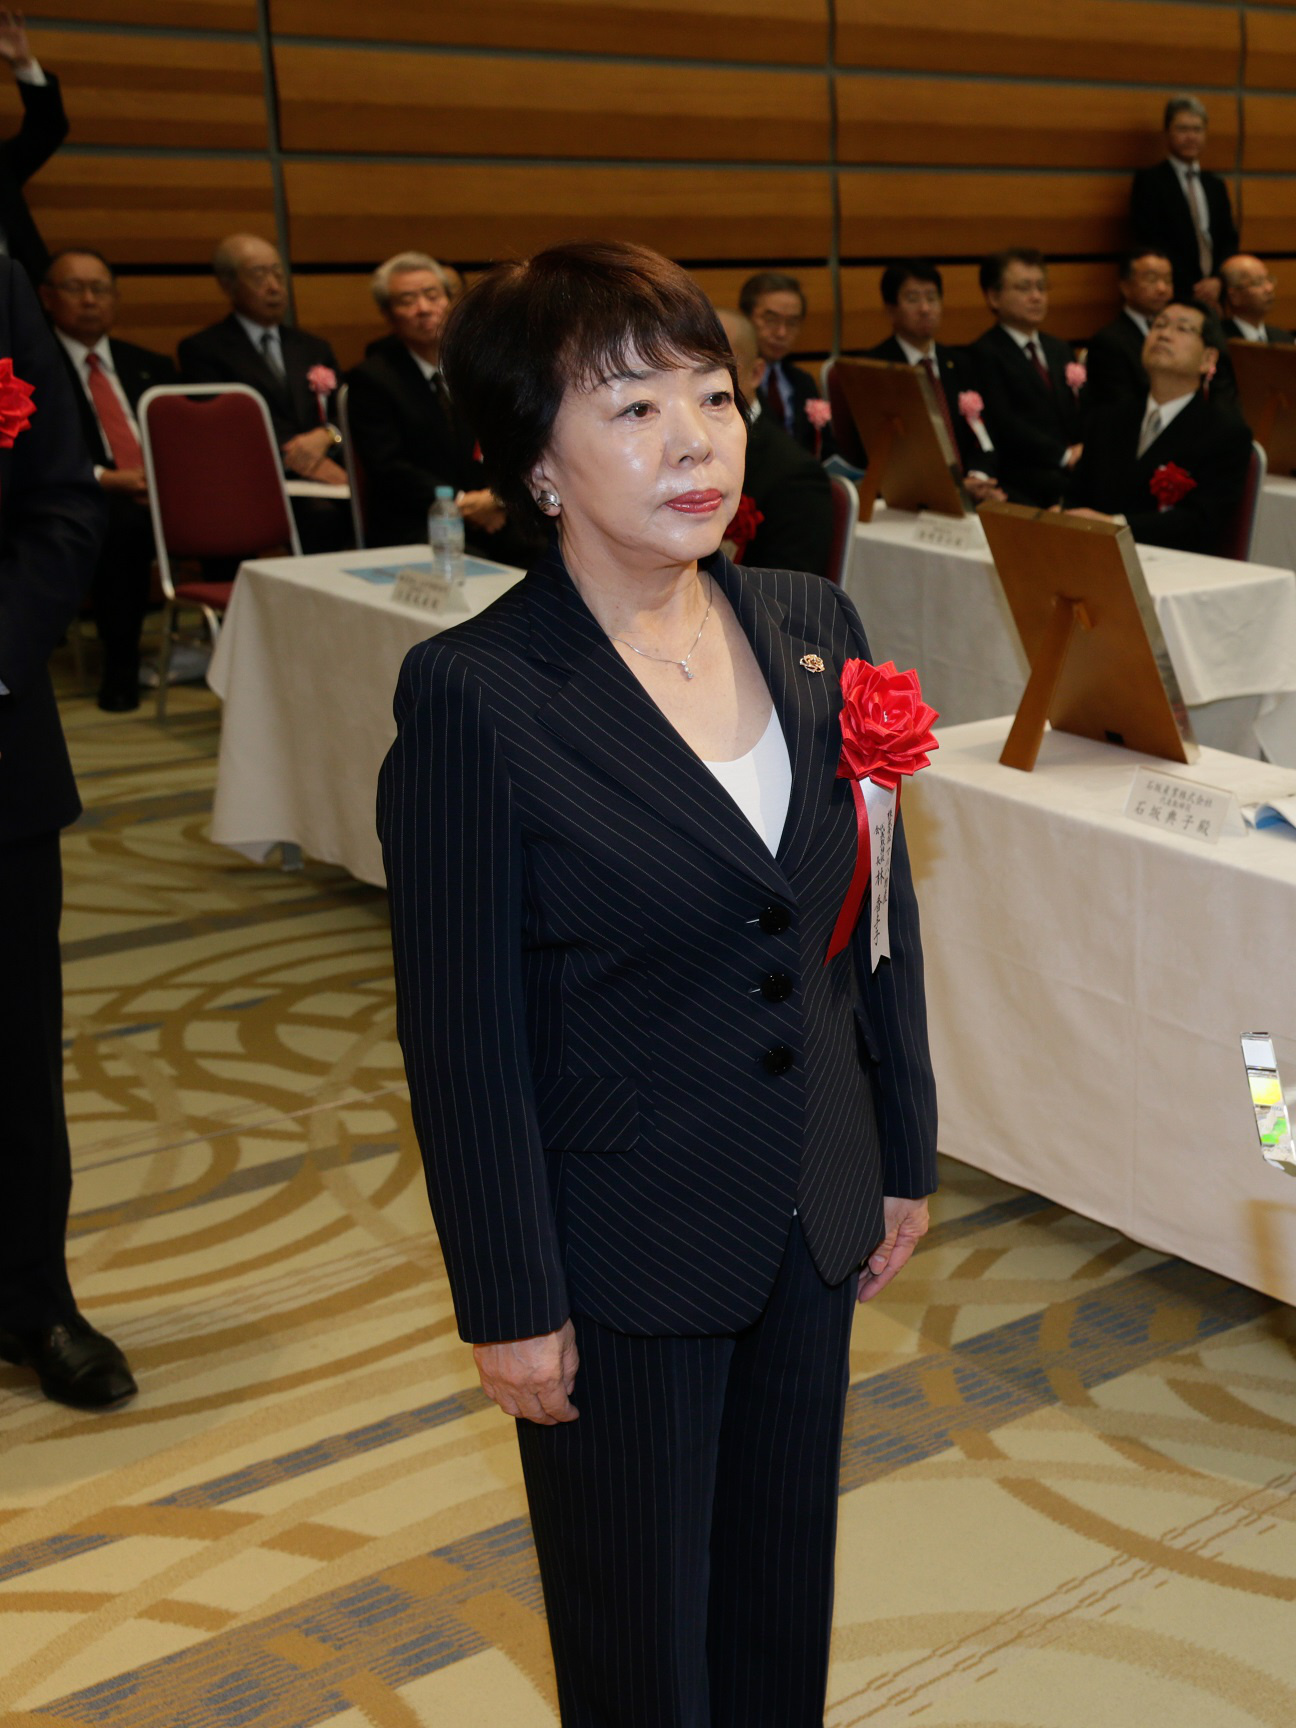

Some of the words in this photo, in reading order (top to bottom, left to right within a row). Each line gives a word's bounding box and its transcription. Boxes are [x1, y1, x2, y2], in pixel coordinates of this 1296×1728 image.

[1134, 800, 1212, 836] 石坂典子殿
